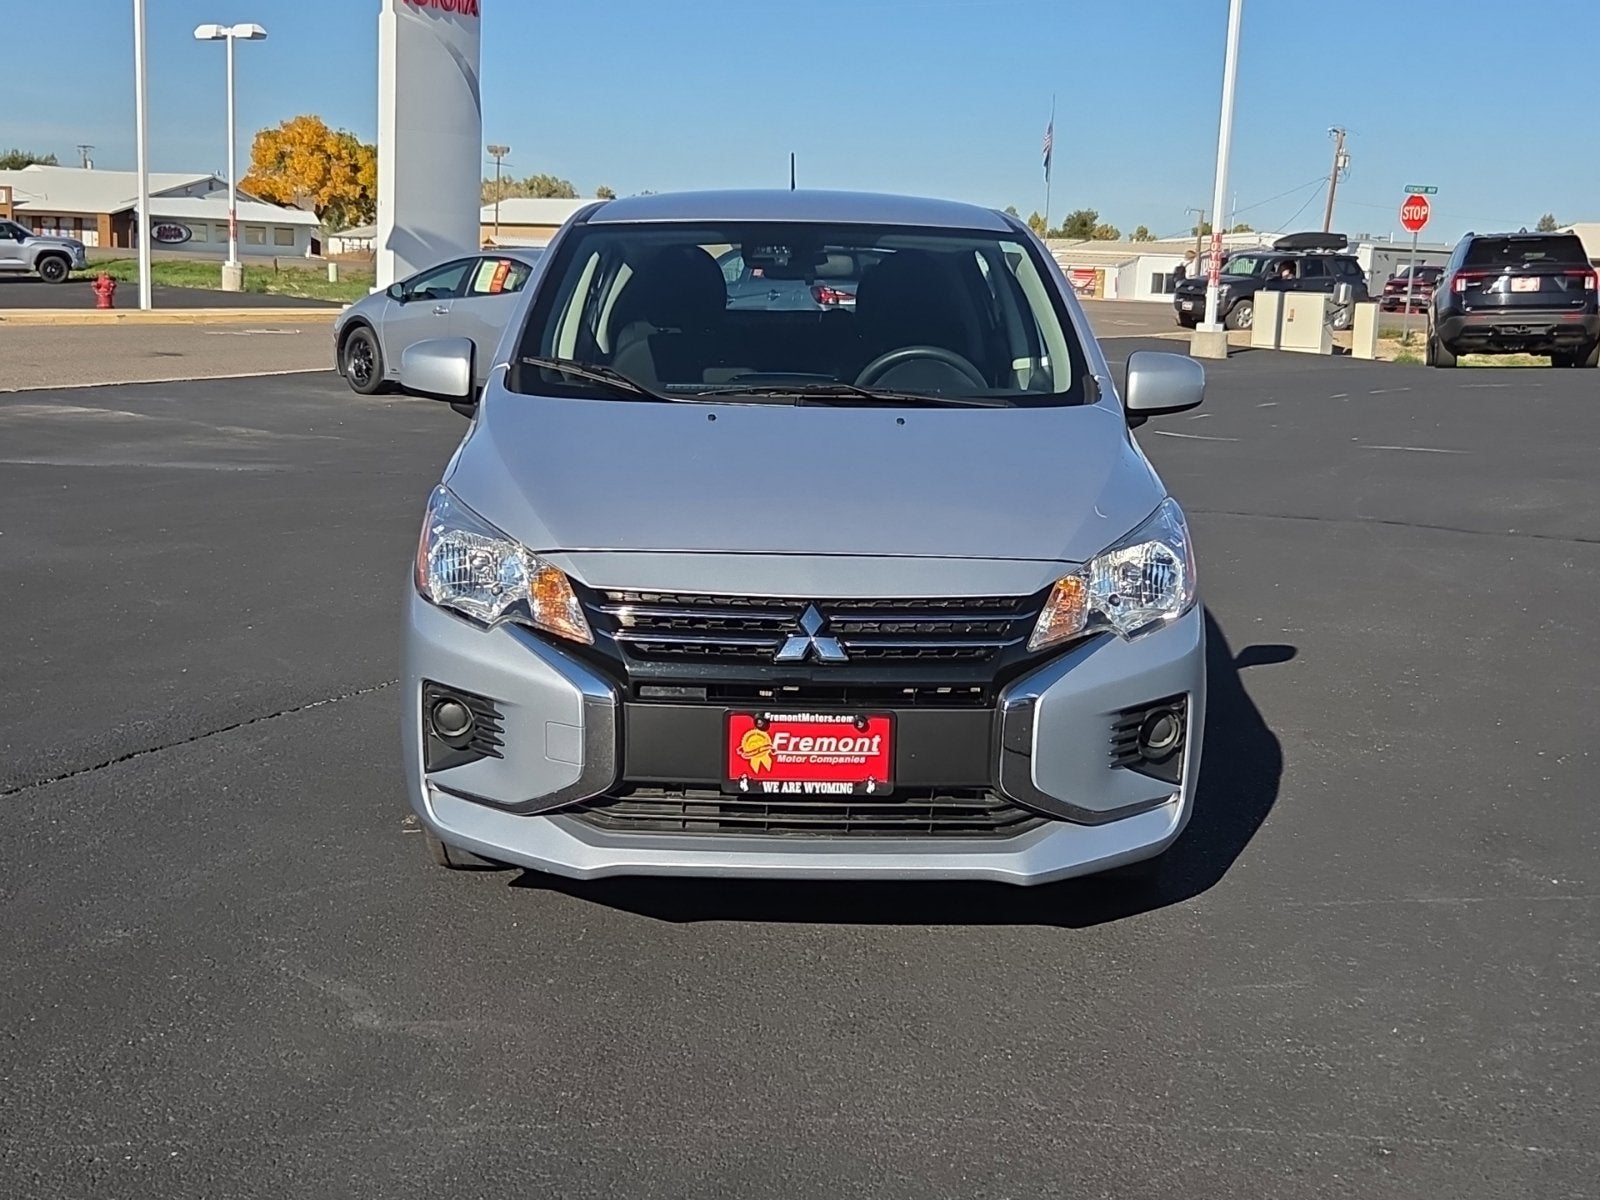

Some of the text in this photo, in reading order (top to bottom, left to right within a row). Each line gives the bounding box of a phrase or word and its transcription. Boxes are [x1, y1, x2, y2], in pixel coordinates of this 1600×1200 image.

[1403, 206, 1428, 220] STOP
[764, 712, 854, 723] FremontMotors.com
[773, 732, 881, 752] Fremont
[777, 754, 866, 764] Motor Companies
[763, 781, 853, 794] WE ARE WYOMING
